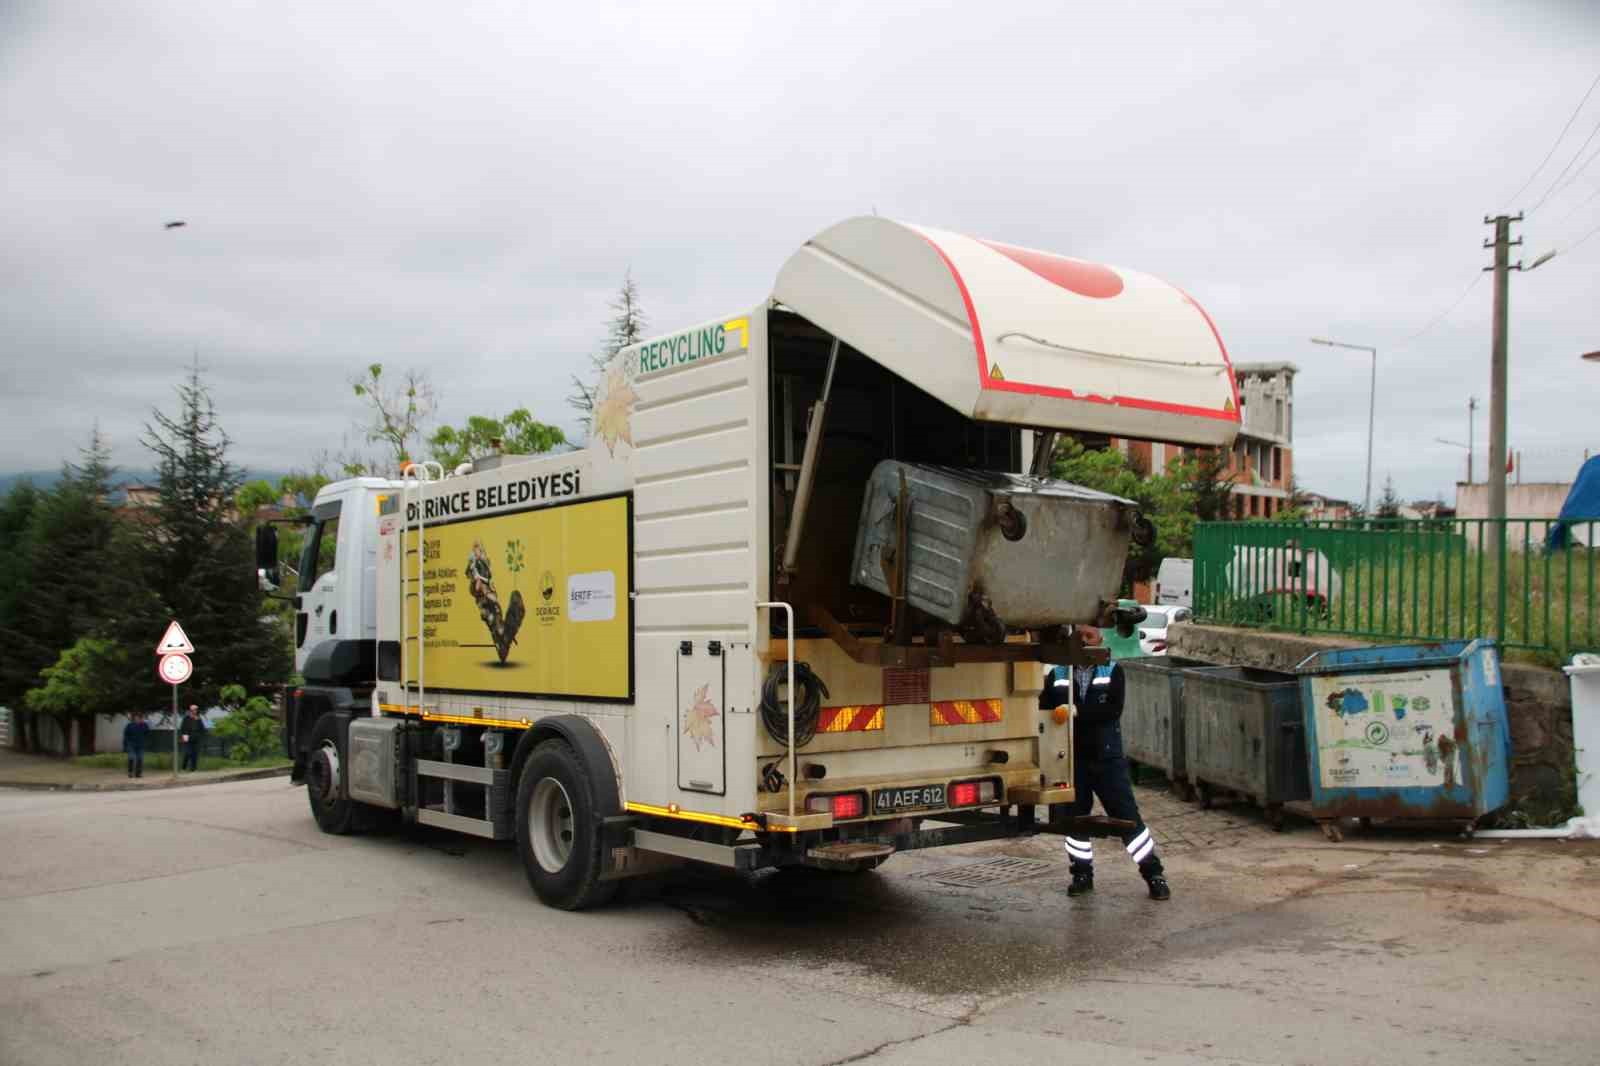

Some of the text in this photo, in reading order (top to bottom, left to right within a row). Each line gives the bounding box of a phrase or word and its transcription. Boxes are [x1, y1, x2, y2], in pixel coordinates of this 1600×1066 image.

[639, 323, 726, 373] RECYCLING
[877, 787, 943, 808] 41 AEF 612
